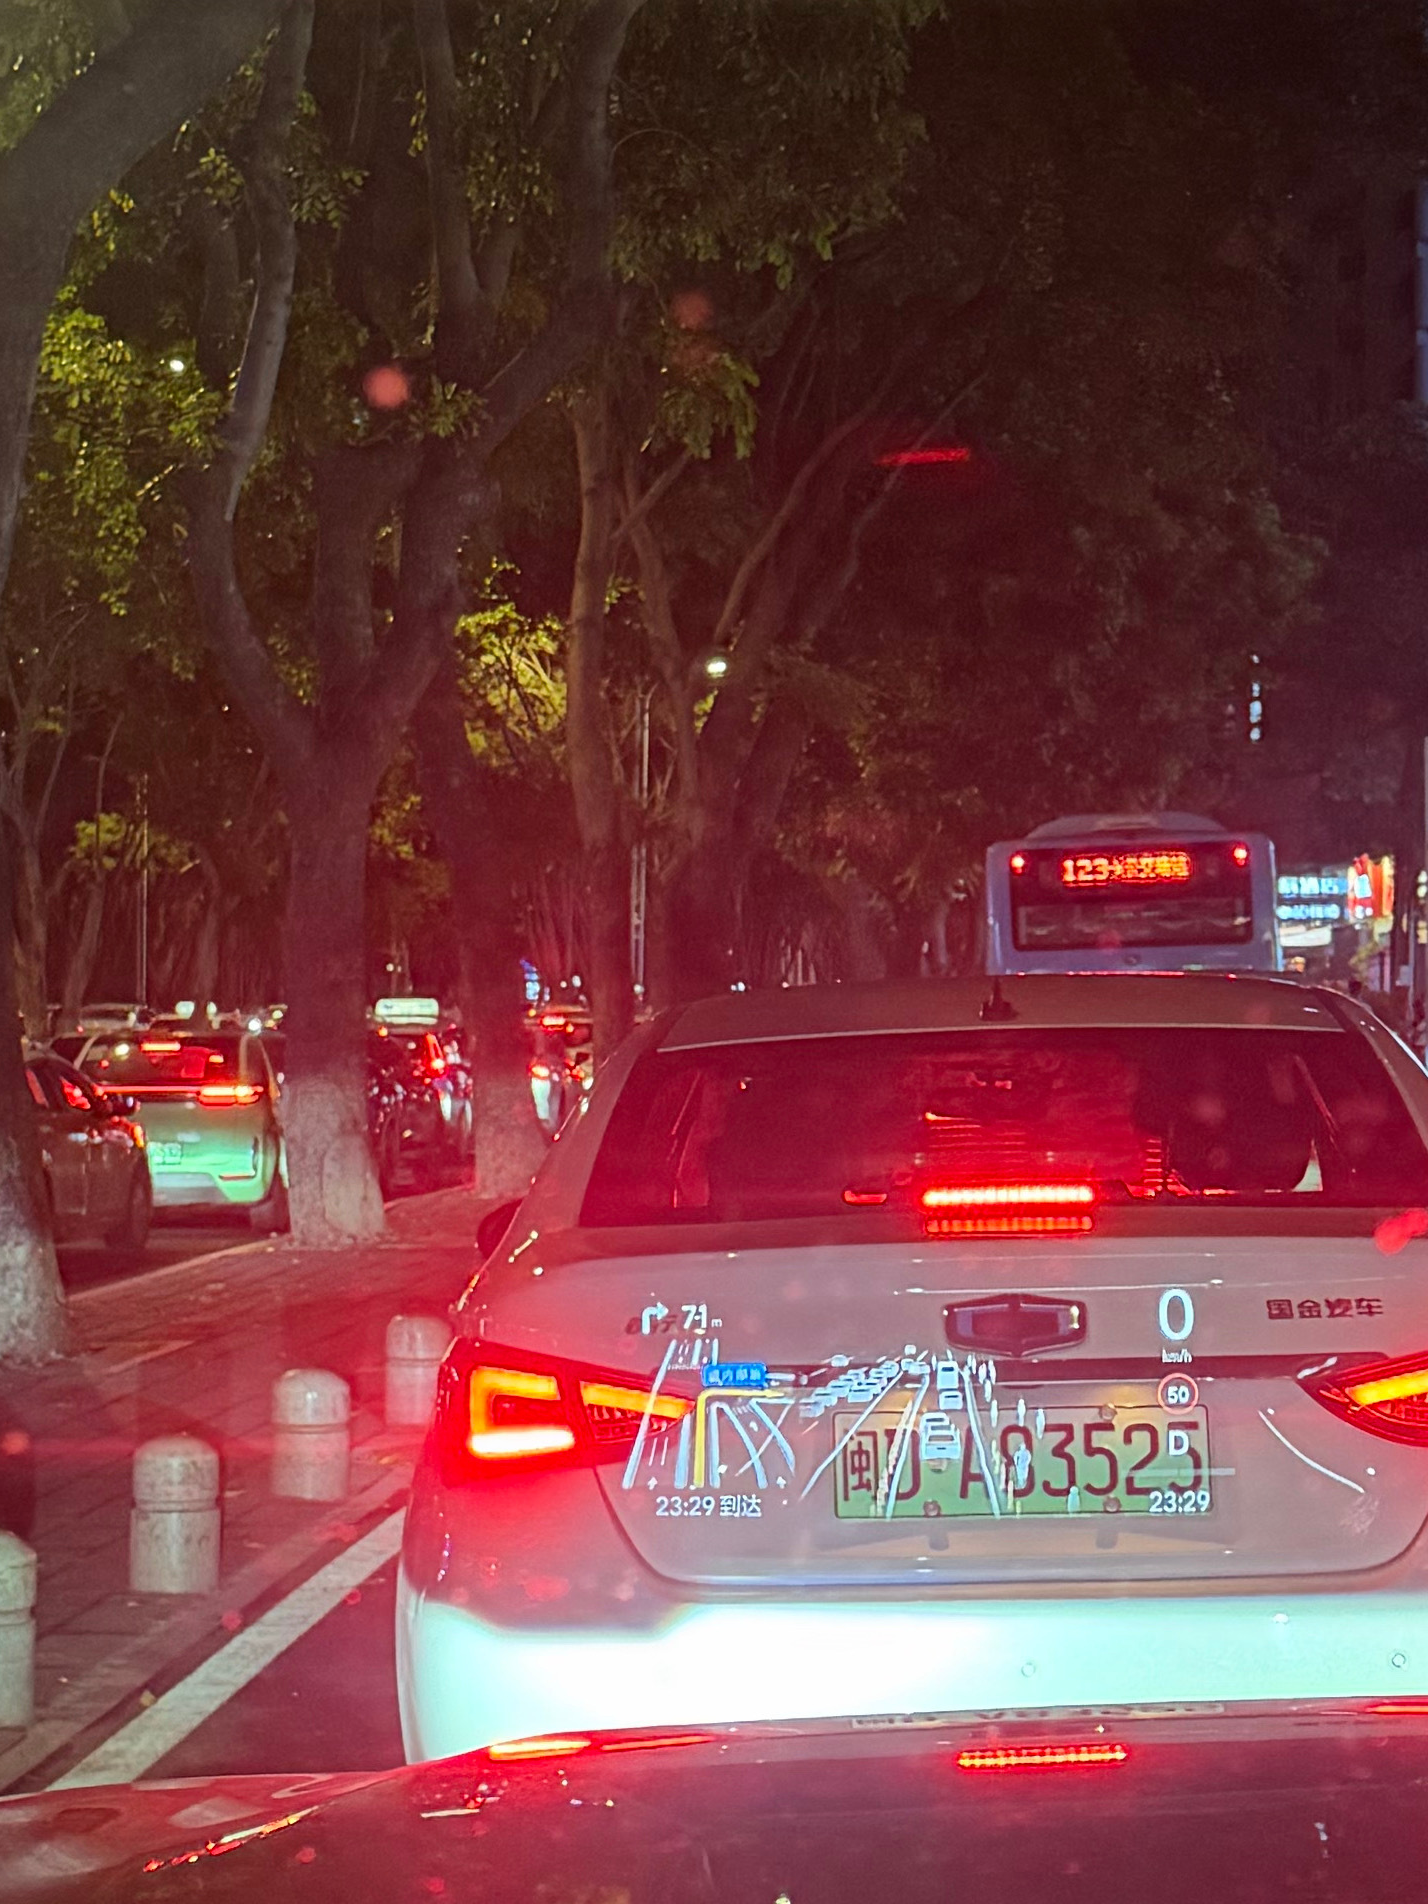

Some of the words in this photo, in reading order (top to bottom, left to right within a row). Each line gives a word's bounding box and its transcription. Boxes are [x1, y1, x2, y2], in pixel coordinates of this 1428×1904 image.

[681, 1303, 708, 1329] 71
[1157, 1288, 1195, 1341] 0
[1161, 1348, 1193, 1364] km/h
[1167, 1385, 1190, 1405] 50
[1168, 1430, 1190, 1457] D
[655, 1495, 716, 1517] 23:29
[719, 1493, 763, 1518] 到达
[1149, 1490, 1211, 1514] 23:29
